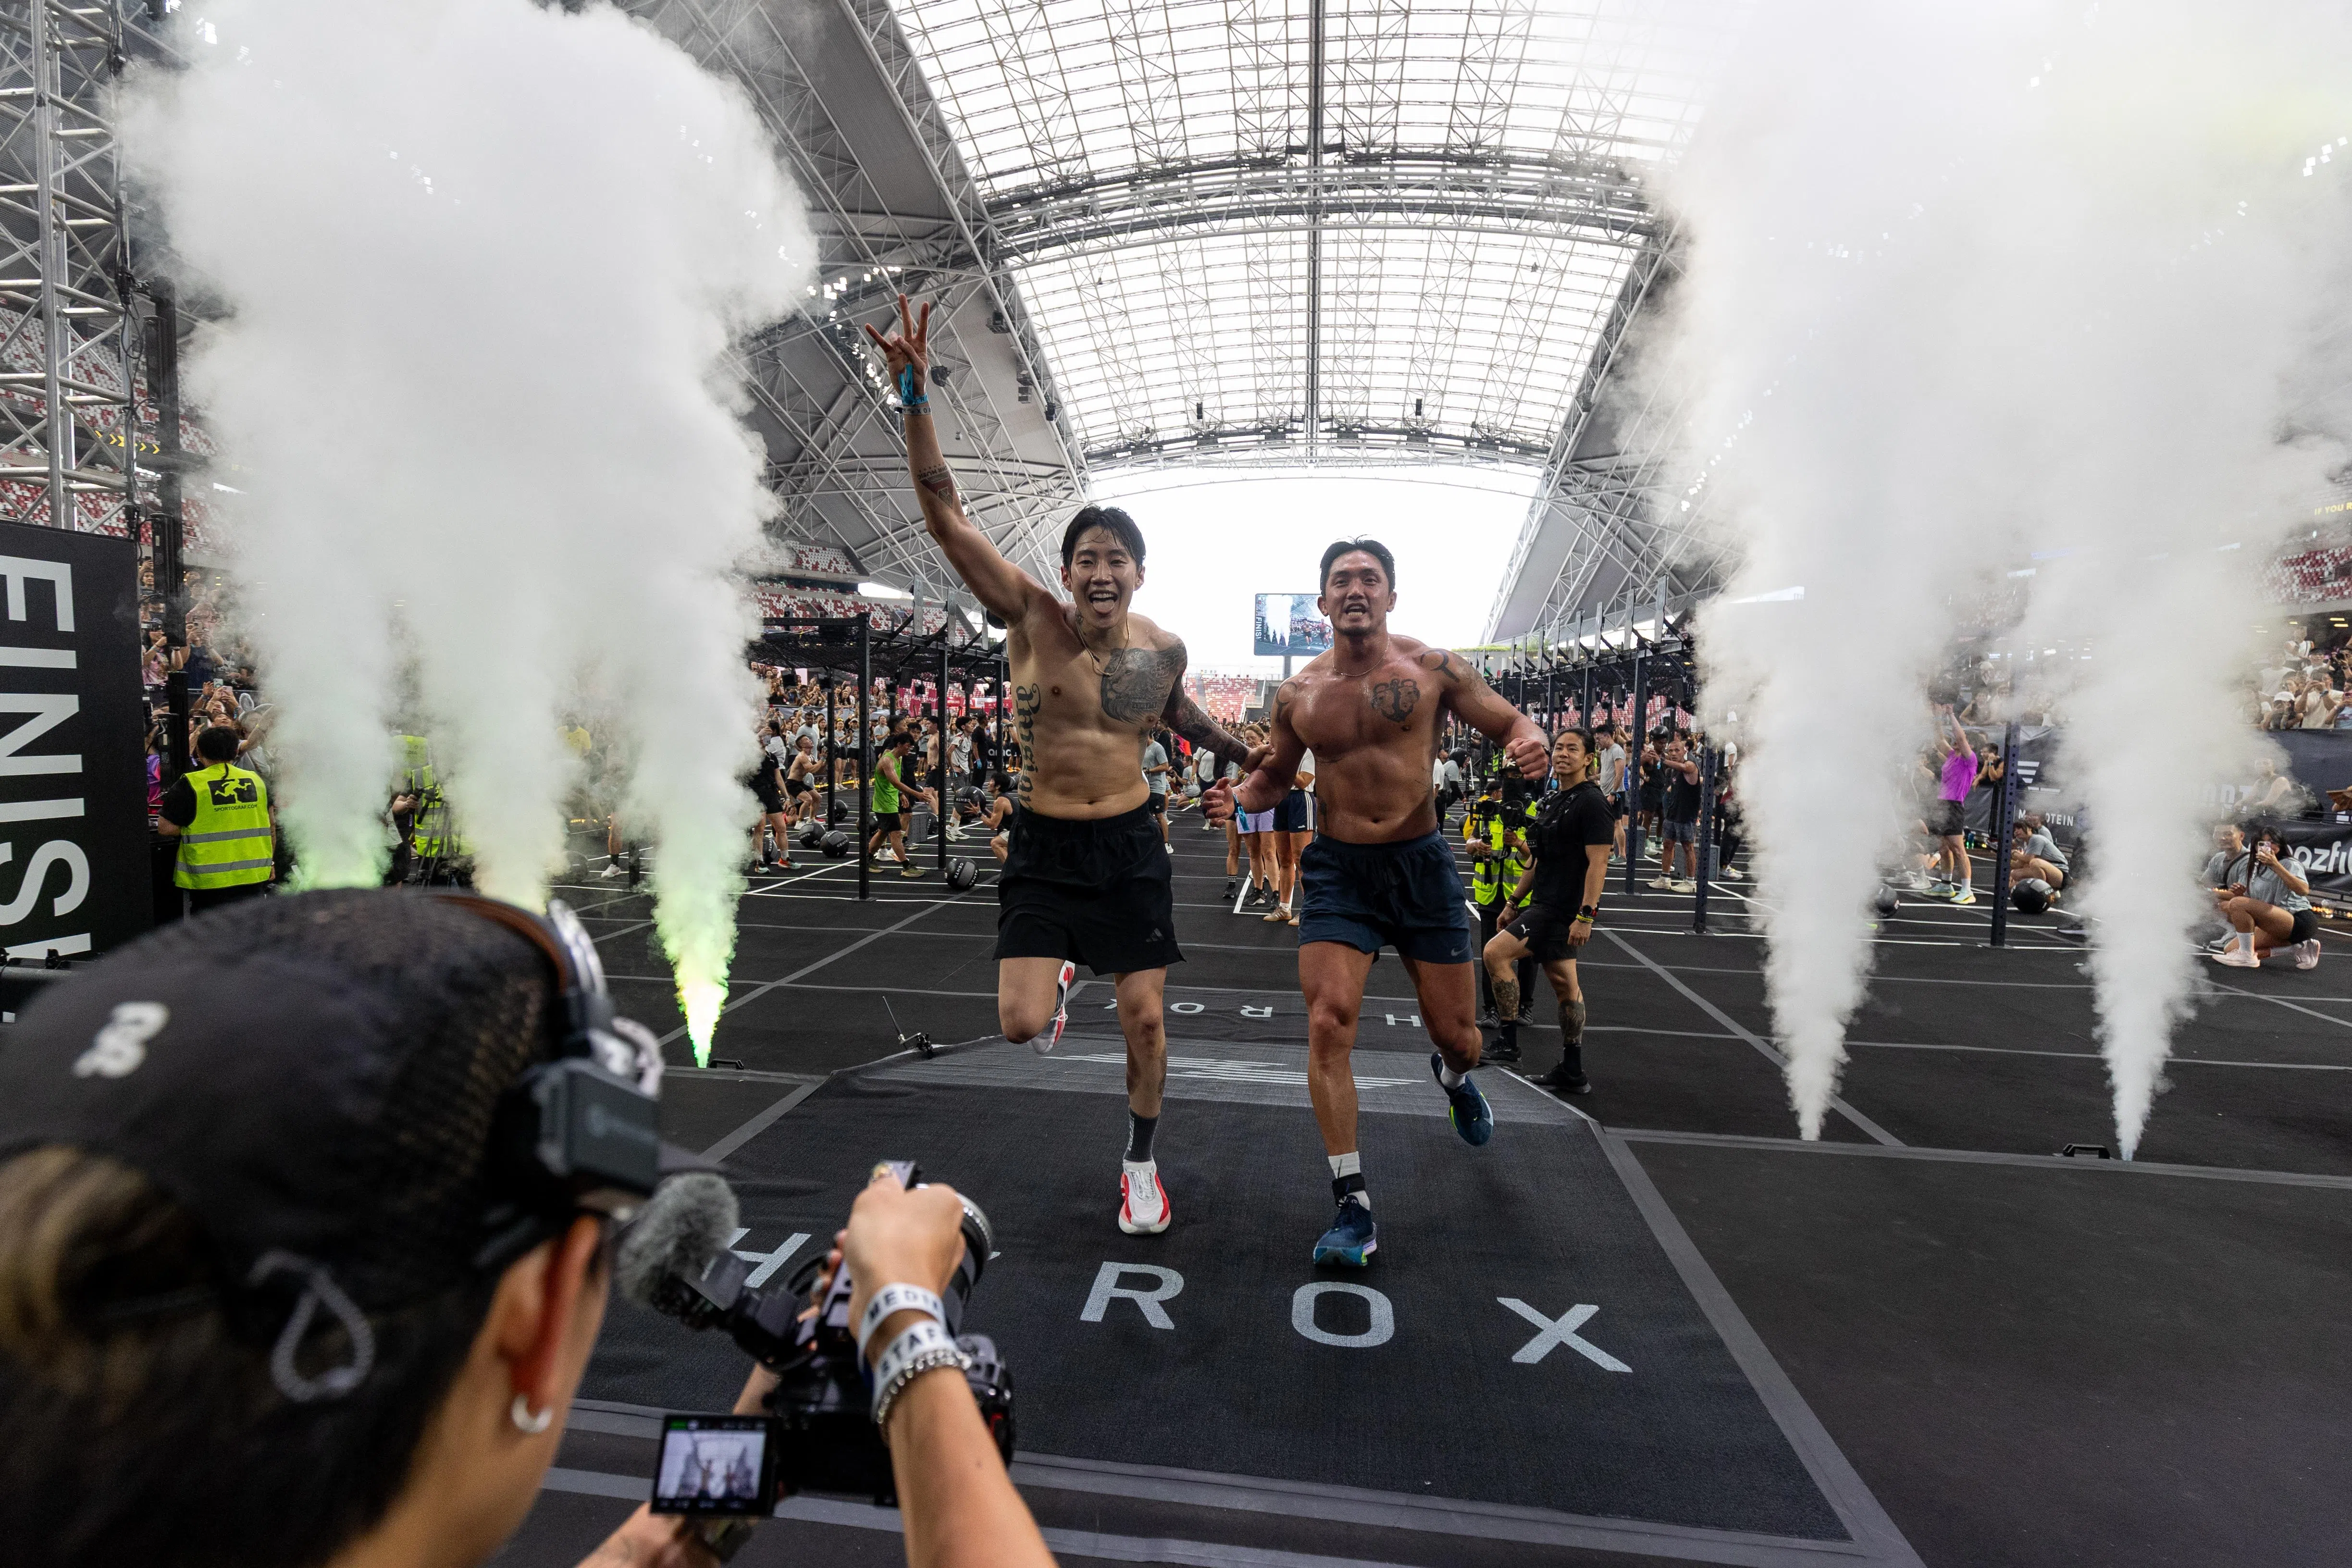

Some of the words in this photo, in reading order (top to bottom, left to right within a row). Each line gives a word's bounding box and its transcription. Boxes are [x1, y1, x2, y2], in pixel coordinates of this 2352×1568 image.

[2325, 504, 2344, 515] YOU
[214, 804, 257, 812] SPORTOGRAF.COM
[2018, 809, 2074, 827] MOTEIN
[954, 863, 964, 879] CENTR
[700, 1228, 1633, 1373] HROX
